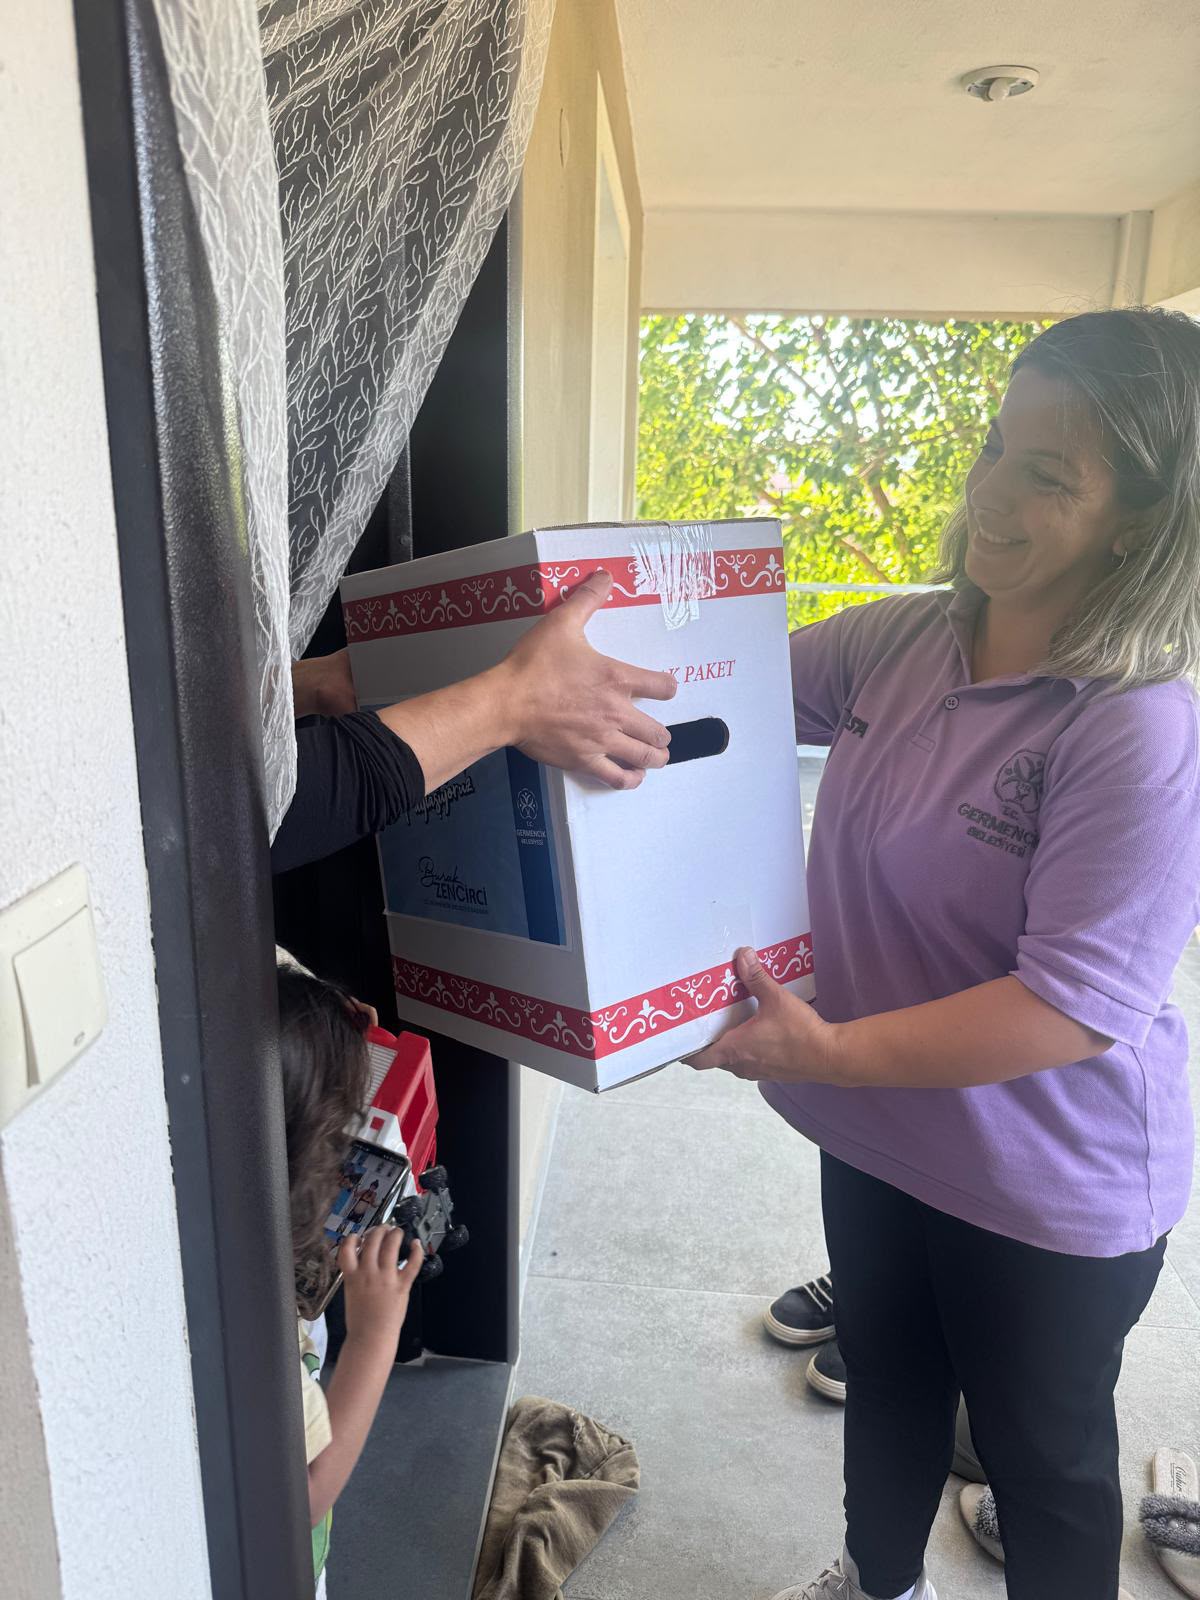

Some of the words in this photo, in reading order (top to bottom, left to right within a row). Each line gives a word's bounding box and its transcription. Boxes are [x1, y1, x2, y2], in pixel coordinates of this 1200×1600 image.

[684, 659, 736, 683] PAKET
[418, 856, 465, 887] Burak
[435, 880, 488, 905] ZENCİRCİ
